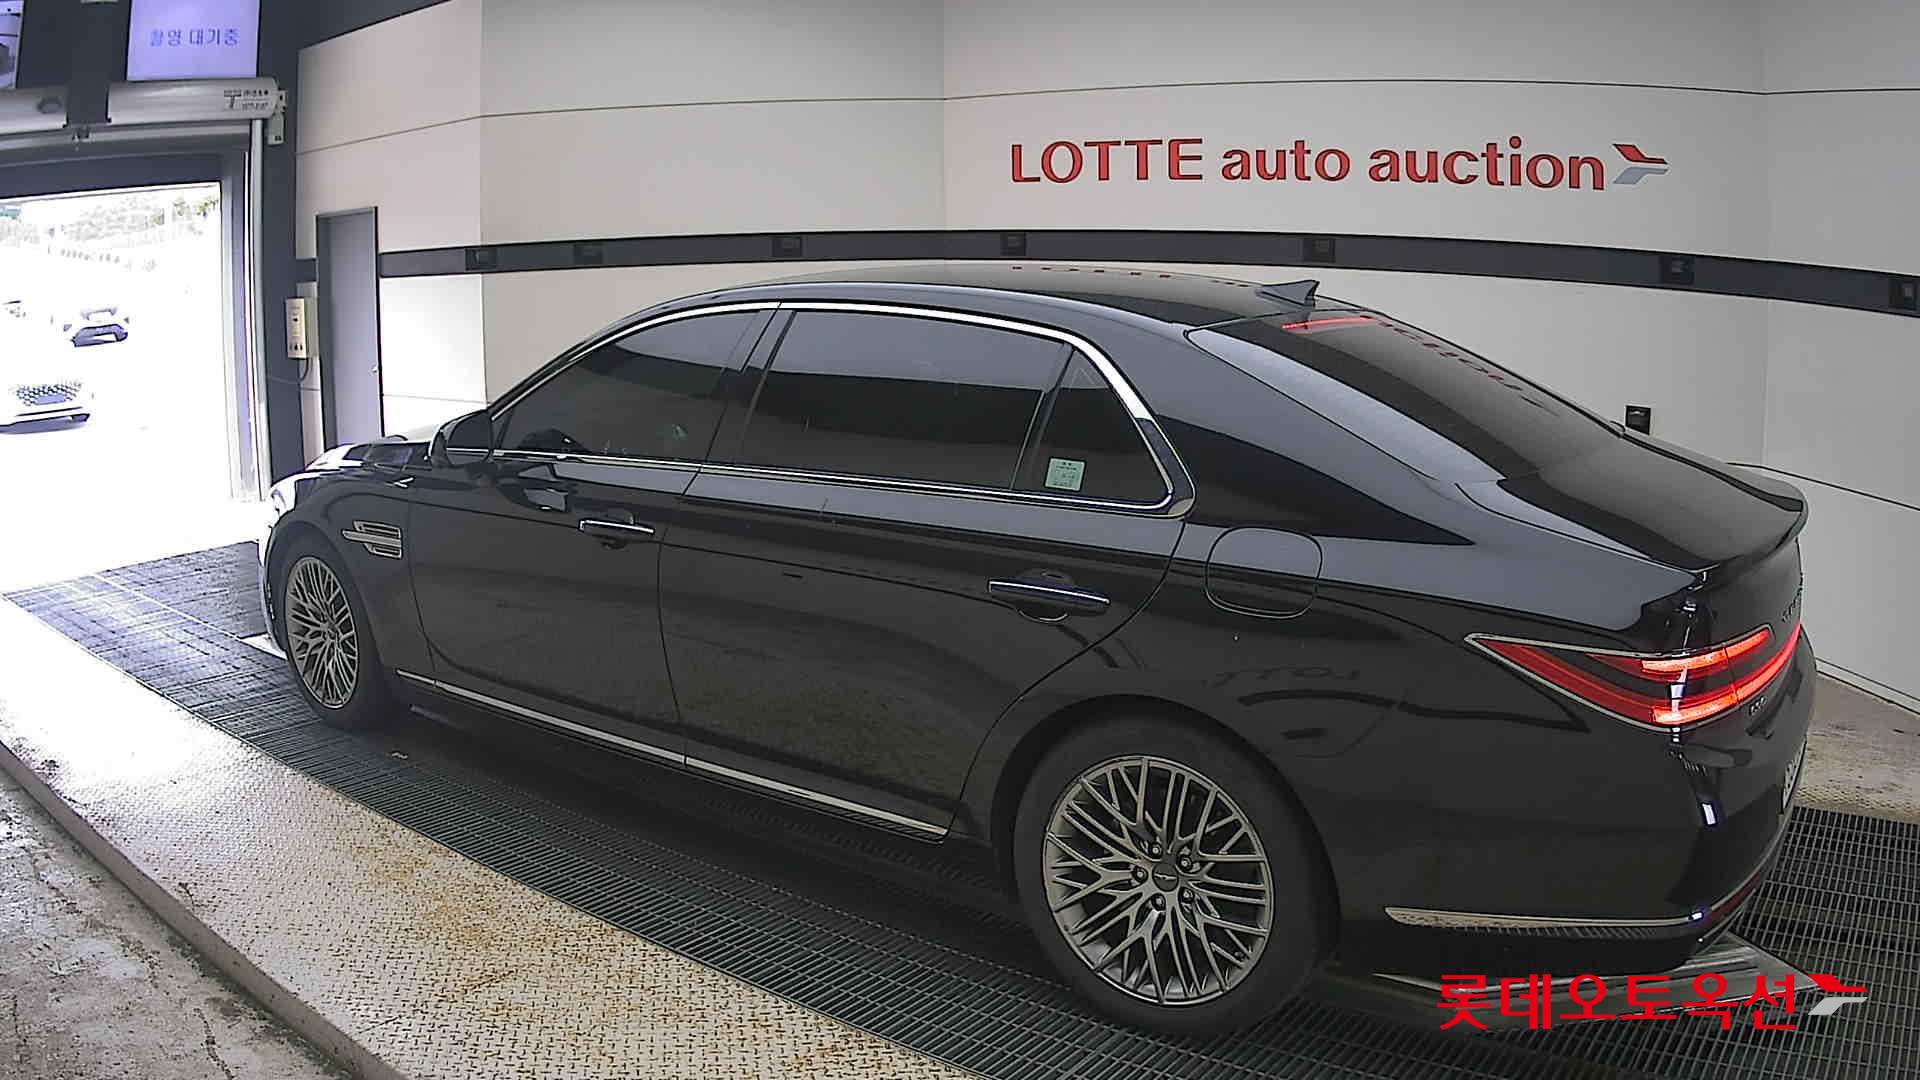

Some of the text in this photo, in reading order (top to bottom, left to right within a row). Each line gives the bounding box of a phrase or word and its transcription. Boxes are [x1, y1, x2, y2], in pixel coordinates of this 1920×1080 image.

[189, 28, 239, 46] 대기중
[1011, 136, 1605, 190] LOTTE auto auction
